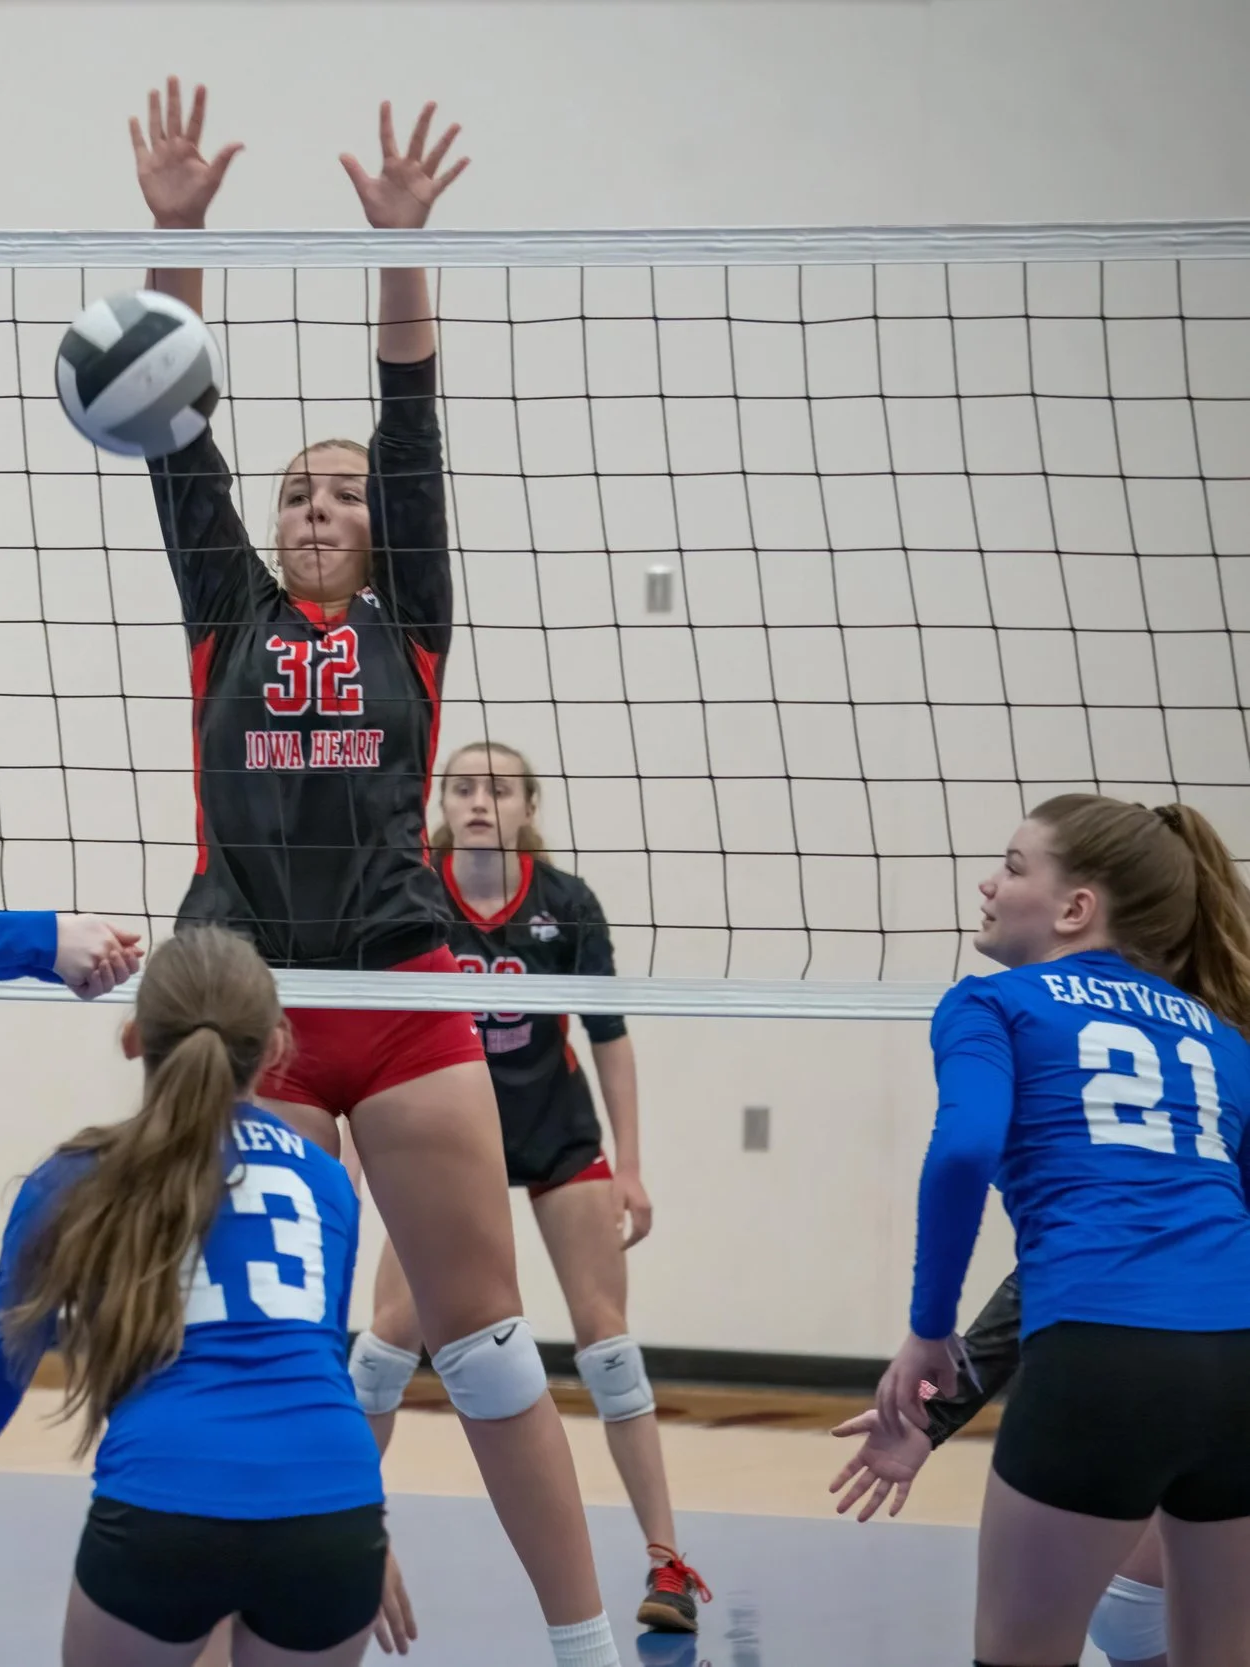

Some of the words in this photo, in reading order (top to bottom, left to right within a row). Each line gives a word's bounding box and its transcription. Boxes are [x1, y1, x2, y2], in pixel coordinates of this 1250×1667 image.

[263, 626, 364, 716] 32
[245, 731, 305, 770] IOWA
[309, 729, 384, 769] HEART
[1041, 974, 1213, 1035] EASTVIEW
[1078, 1020, 1231, 1164] 21
[222, 1118, 306, 1160] IEW
